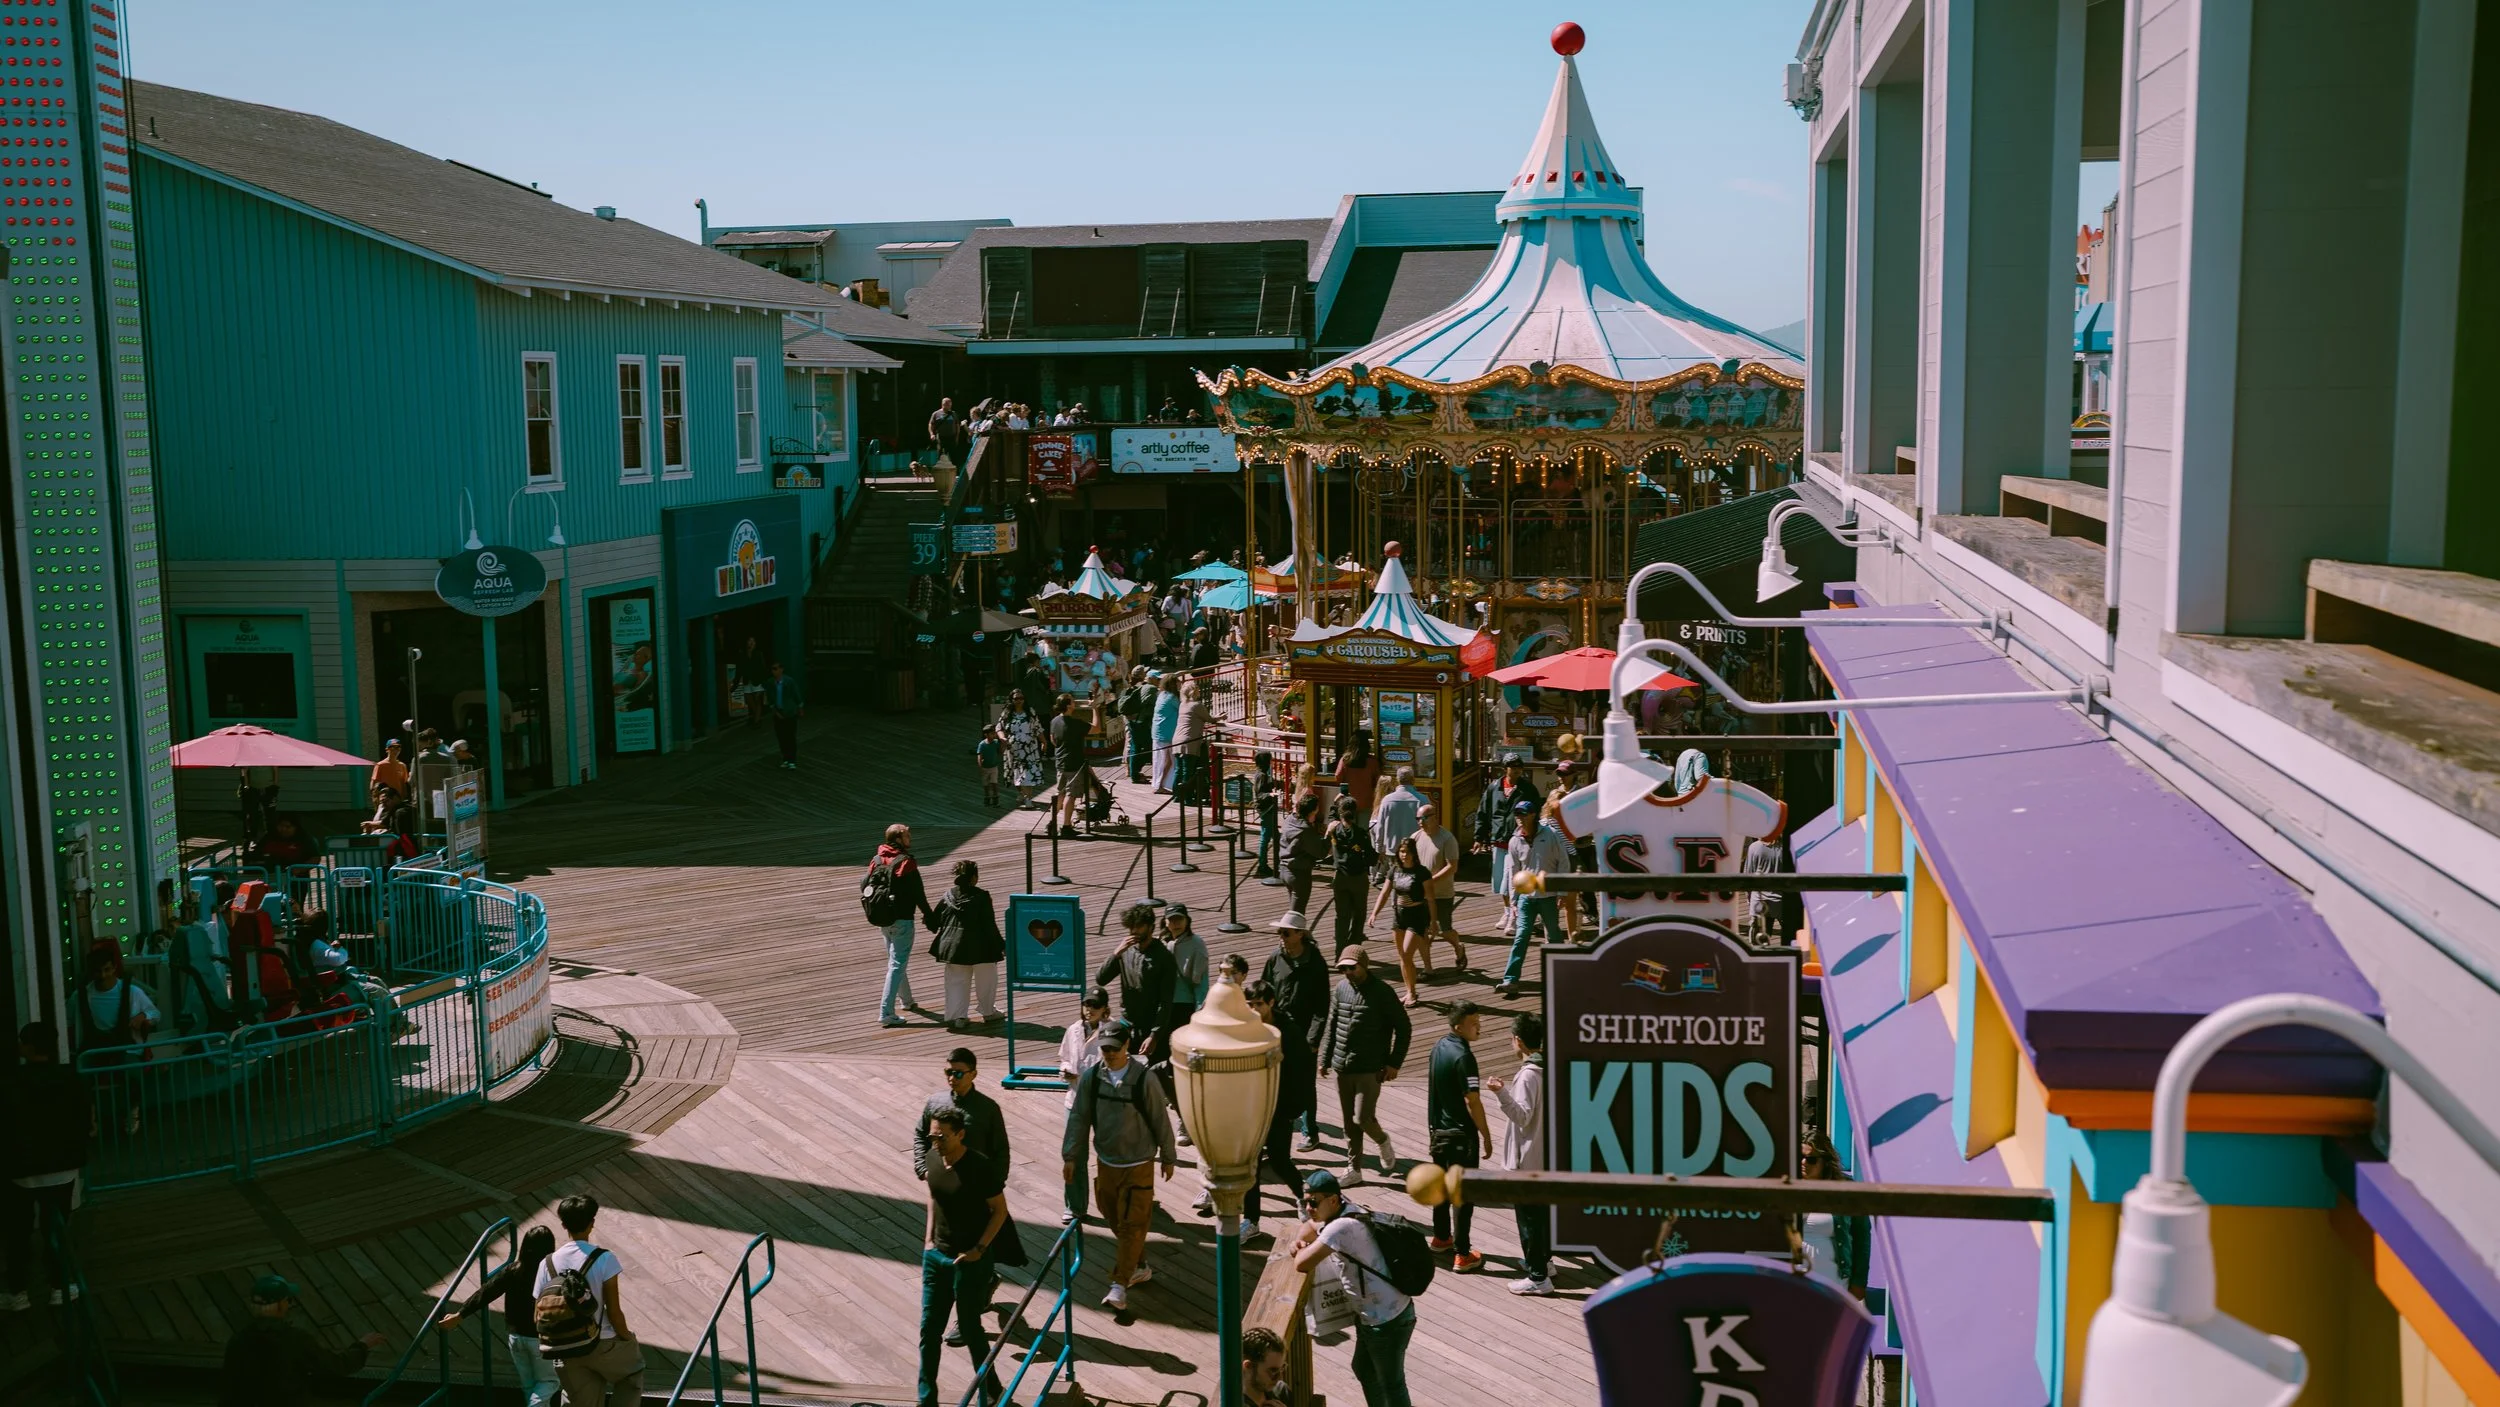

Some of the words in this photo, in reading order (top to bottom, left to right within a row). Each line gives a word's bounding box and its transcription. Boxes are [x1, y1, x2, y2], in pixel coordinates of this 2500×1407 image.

[1033, 442, 1067, 452] FUNNEL
[1141, 443, 1169, 456] artly
[1171, 441, 1210, 454] coffee
[1038, 451, 1064, 460] CAKES
[913, 533, 936, 542] PIER
[912, 543, 937, 565] 39
[473, 577, 513, 590] AQUA
[719, 559, 775, 595] WORKSHOP
[1043, 603, 1104, 614] CHURROS
[619, 615, 642, 623] AQUA
[234, 634, 260, 642] AQUA
[916, 634, 936, 643] PEPSI
[1680, 624, 1693, 639] &
[1696, 625, 1747, 645] PRINTS
[1336, 644, 1408, 658] CAROUSEL
[486, 984, 502, 1003] SEE
[503, 976, 517, 994] THE
[489, 1011, 520, 1034] BEFORE
[1579, 1014, 1765, 1046] SHIRTIQUE
[1569, 1060, 1776, 1179] KIDS
